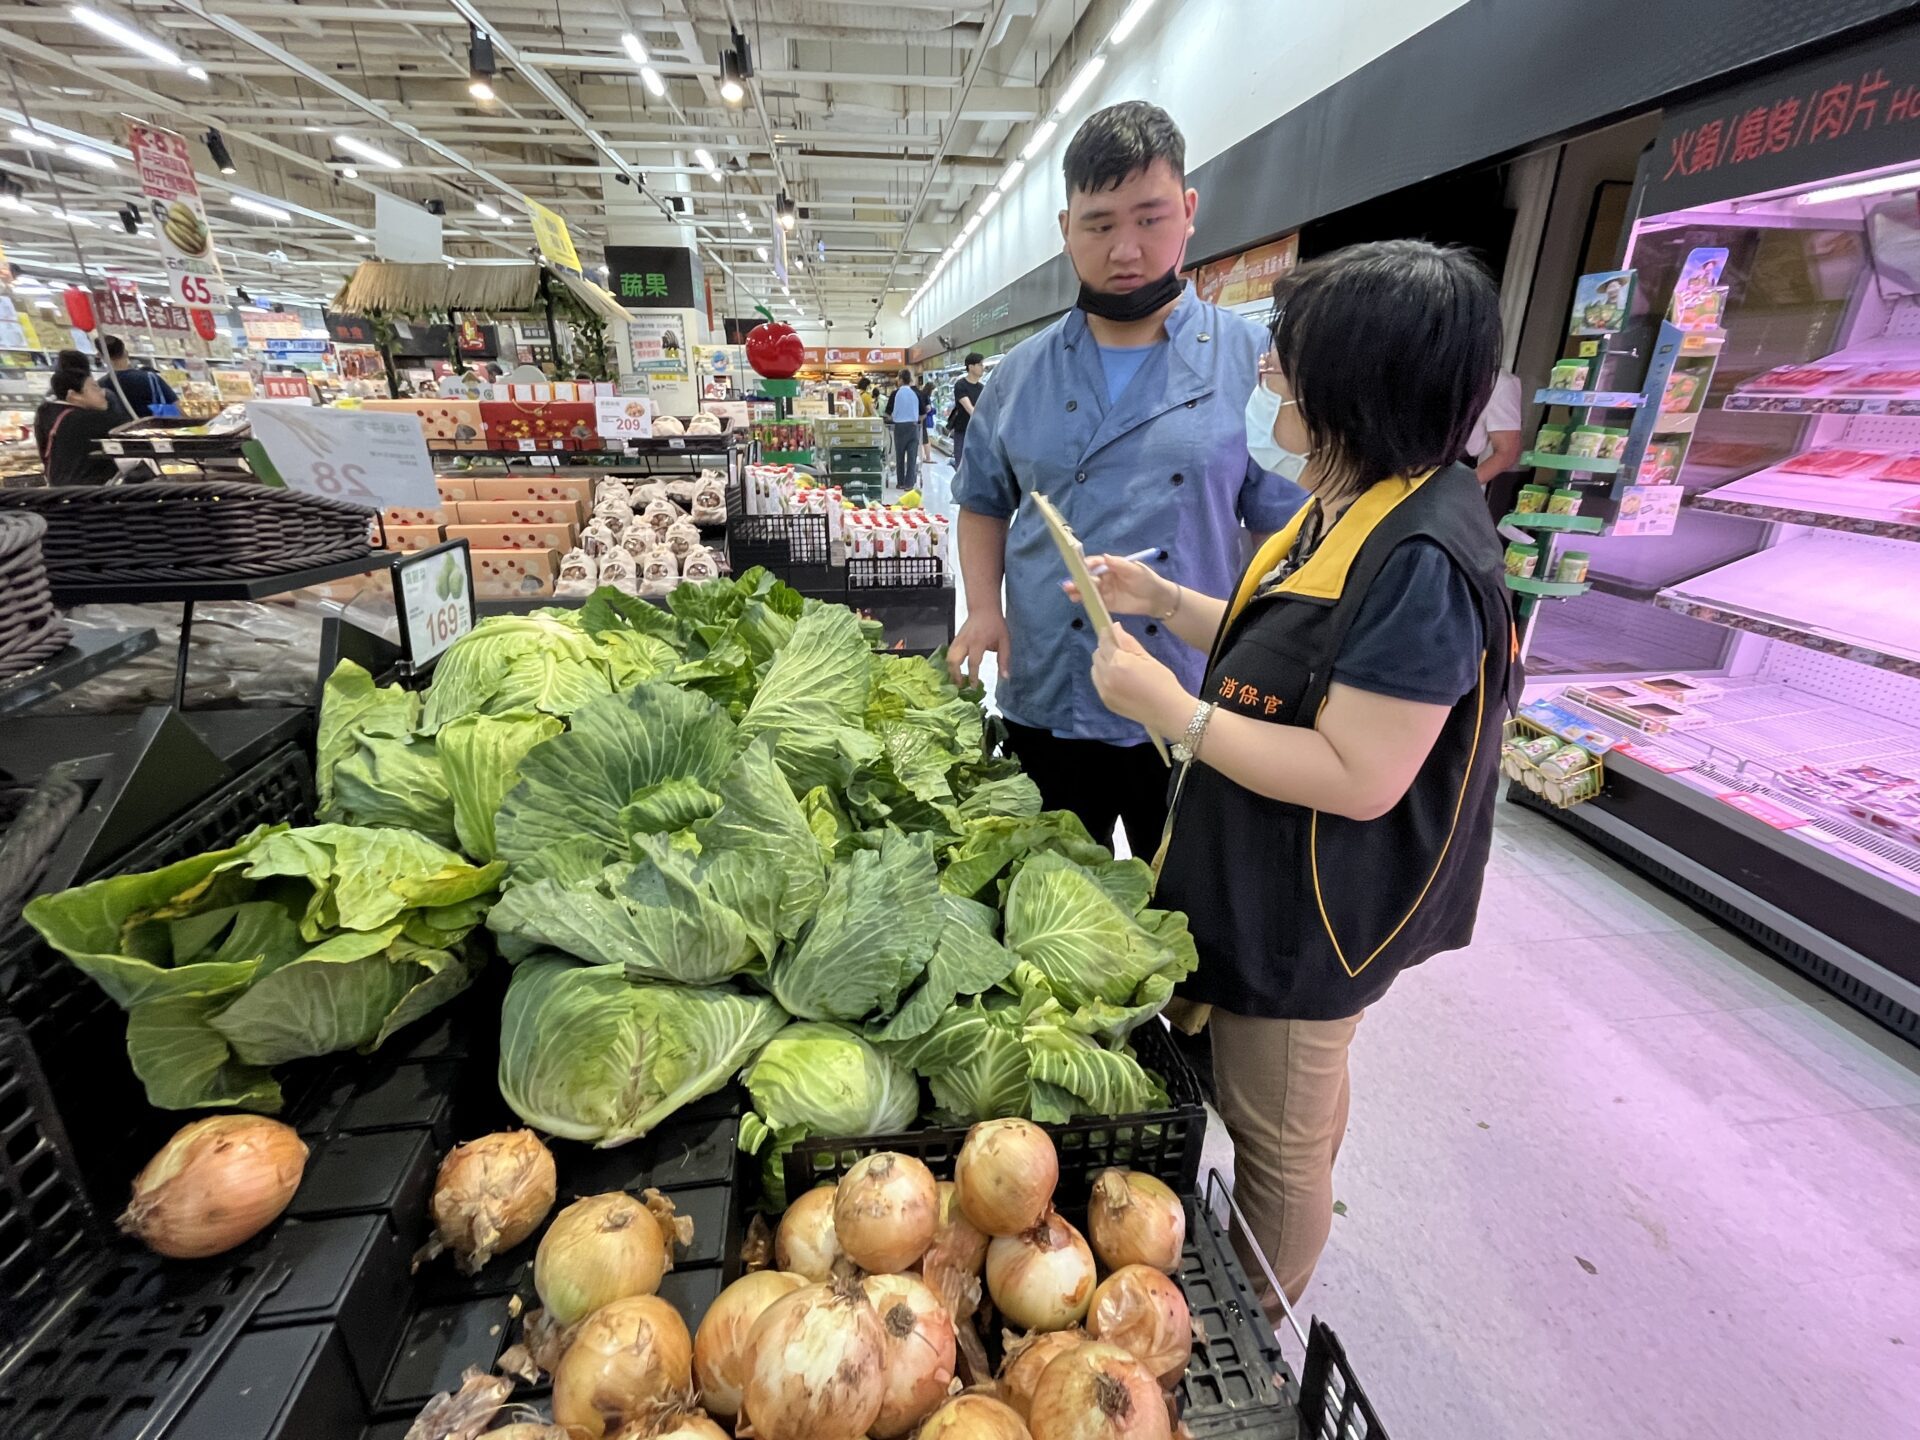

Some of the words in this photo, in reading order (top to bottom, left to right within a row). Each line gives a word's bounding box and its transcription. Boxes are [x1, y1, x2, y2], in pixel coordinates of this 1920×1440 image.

[1663, 68, 1890, 182] 火鍋/燒烤/肉片
[181, 275, 211, 304] 65
[620, 273, 669, 298] 蔬果
[615, 418, 641, 431] 209
[426, 603, 458, 648] 169
[1219, 676, 1283, 714] 消保官
